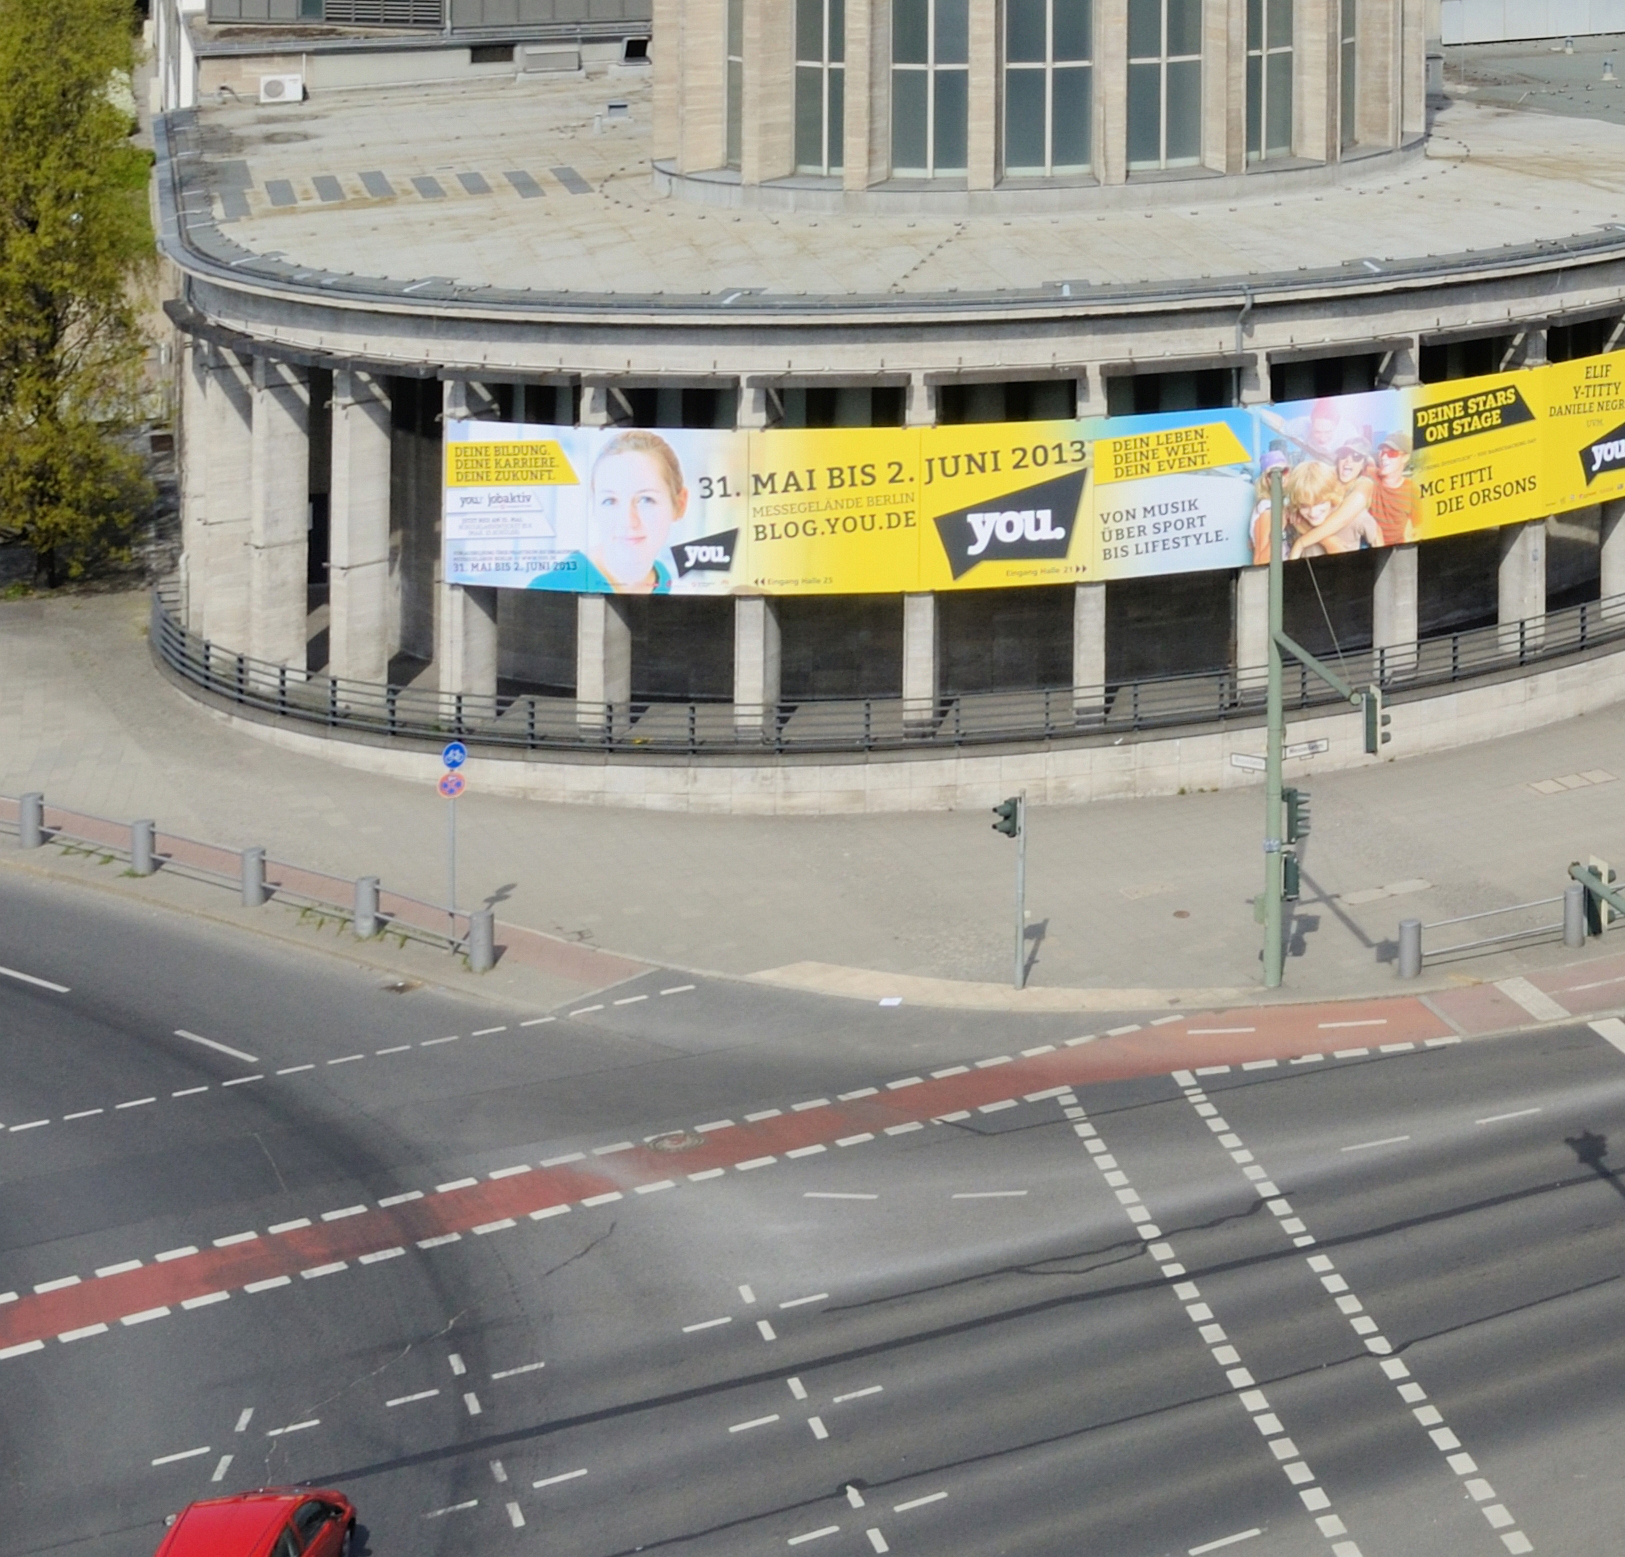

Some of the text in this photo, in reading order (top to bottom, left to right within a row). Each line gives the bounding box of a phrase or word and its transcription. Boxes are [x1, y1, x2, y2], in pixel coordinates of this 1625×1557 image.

[1585, 364, 1612, 379] ELIF
[1573, 381, 1622, 399] Y-TITTY
[1416, 387, 1516, 427] DEINE STARS
[1548, 403, 1595, 417] DANIELE
[1425, 409, 1502, 443] ON STAGE
[454, 445, 552, 457] DEINE BILDUNG.
[1112, 428, 1210, 453] DEIN LEBEN.
[456, 457, 560, 470] DEINE KARRIERE.
[1113, 441, 1210, 466] DEINE WELT.
[1114, 453, 1210, 479] DEIN EVENT.
[456, 469, 556, 482] DEINE ZUKUNFT.
[698, 440, 1088, 499] 31. MAI BIS 2. JUNI 2013
[1420, 465, 1493, 499] MC FITTI
[488, 492, 532, 507] jobaktiv
[752, 492, 916, 518] MESSEGELÄNDE BERLIN
[1436, 495, 1465, 516] DIE
[1469, 475, 1537, 507] ORSONS
[1099, 498, 1199, 525] VON MUSIK
[754, 511, 917, 542] BLOG.YOU.DE
[966, 509, 1066, 555] you.
[1102, 515, 1207, 543] ÜBER SPORT
[684, 545, 730, 568] you.
[1102, 530, 1230, 561] BIS LIFESTYLE.
[454, 561, 578, 573] 31. MAI BIS 2. JUNI 2013
[1006, 566, 1073, 577] Eingang Halle 21
[768, 578, 799, 586] Eingang
